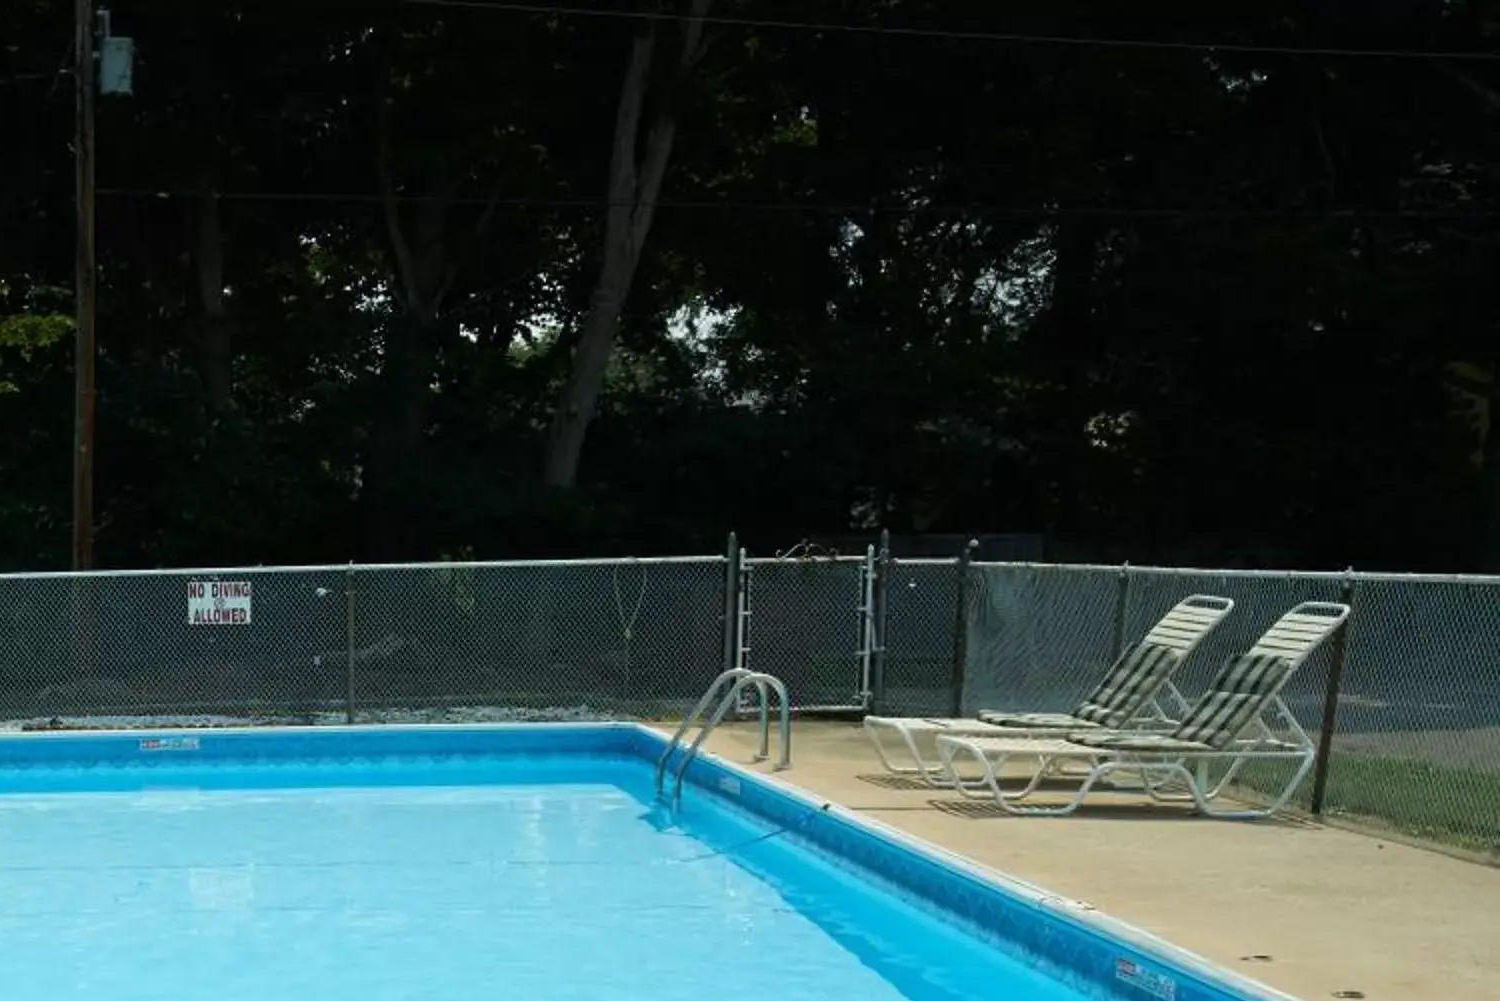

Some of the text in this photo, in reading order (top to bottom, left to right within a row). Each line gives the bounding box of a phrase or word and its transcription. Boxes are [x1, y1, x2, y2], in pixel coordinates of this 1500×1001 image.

[189, 582, 250, 598] NO DIVING
[194, 607, 247, 623] ALLOWED
